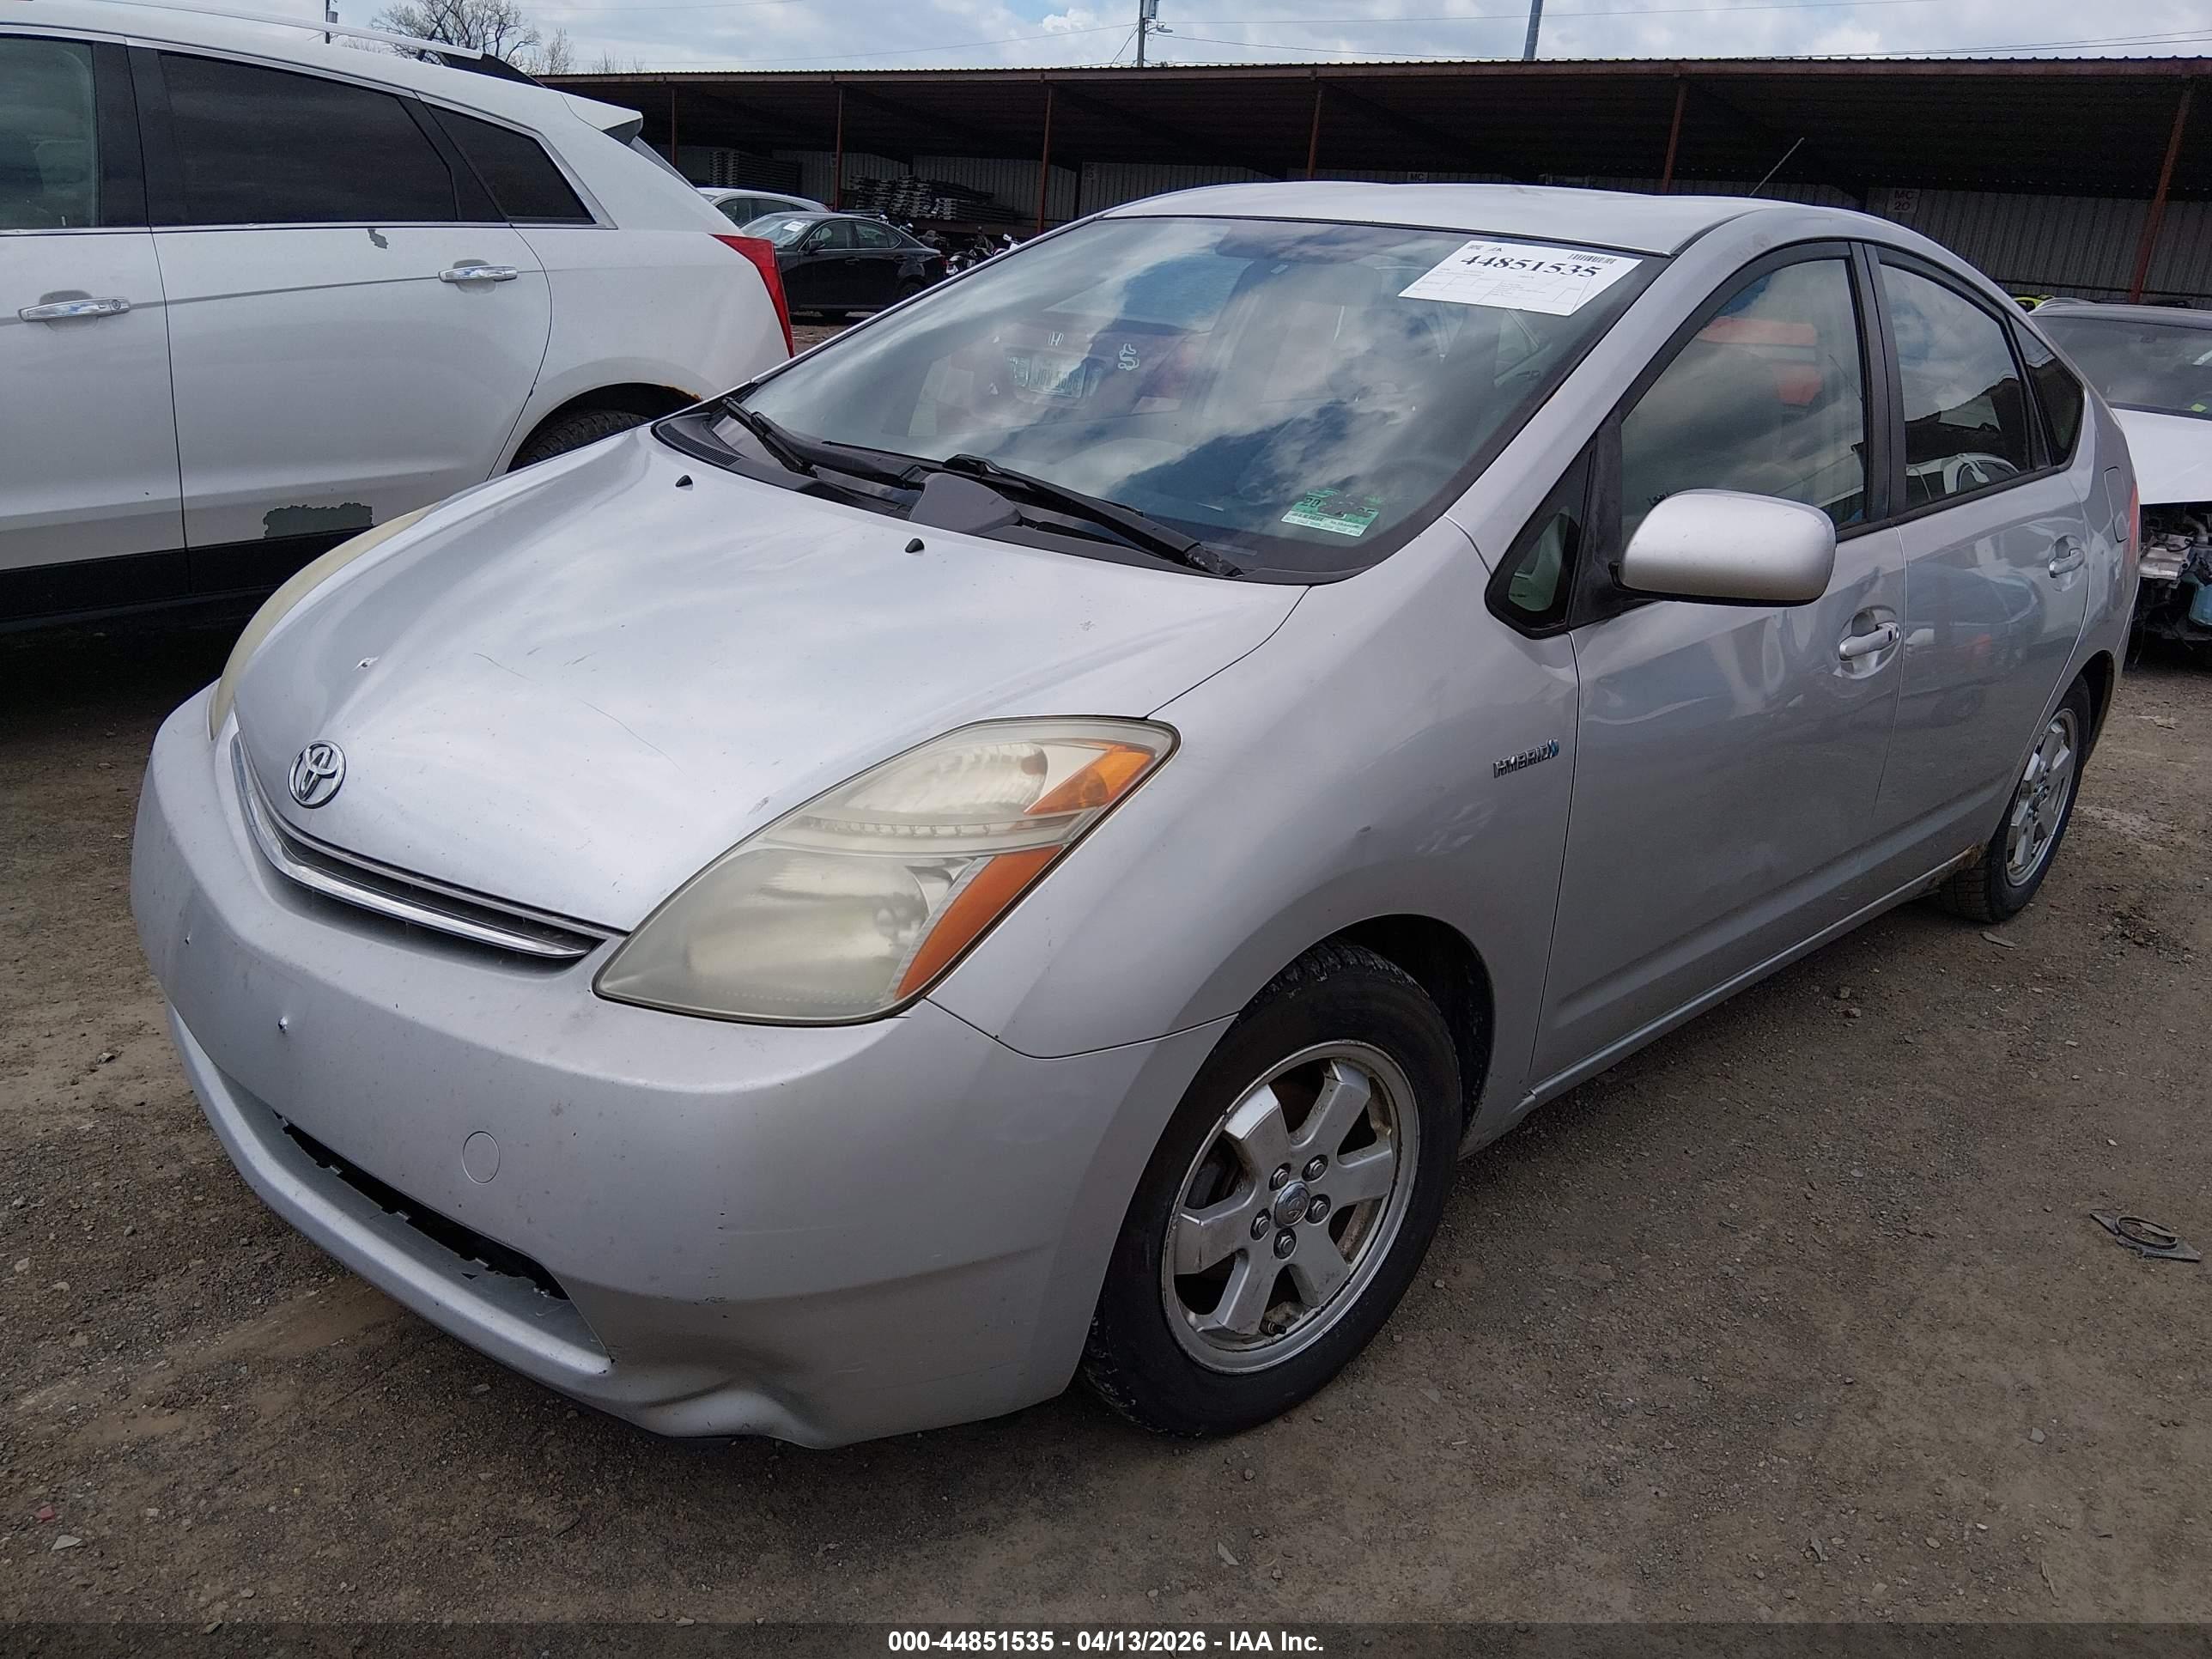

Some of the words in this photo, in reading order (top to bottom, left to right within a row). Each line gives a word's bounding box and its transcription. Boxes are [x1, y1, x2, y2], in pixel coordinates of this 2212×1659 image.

[1894, 201, 1911, 211] 20
[1461, 254, 1603, 278] 44851535
[1492, 744, 1549, 779] HYBRID
